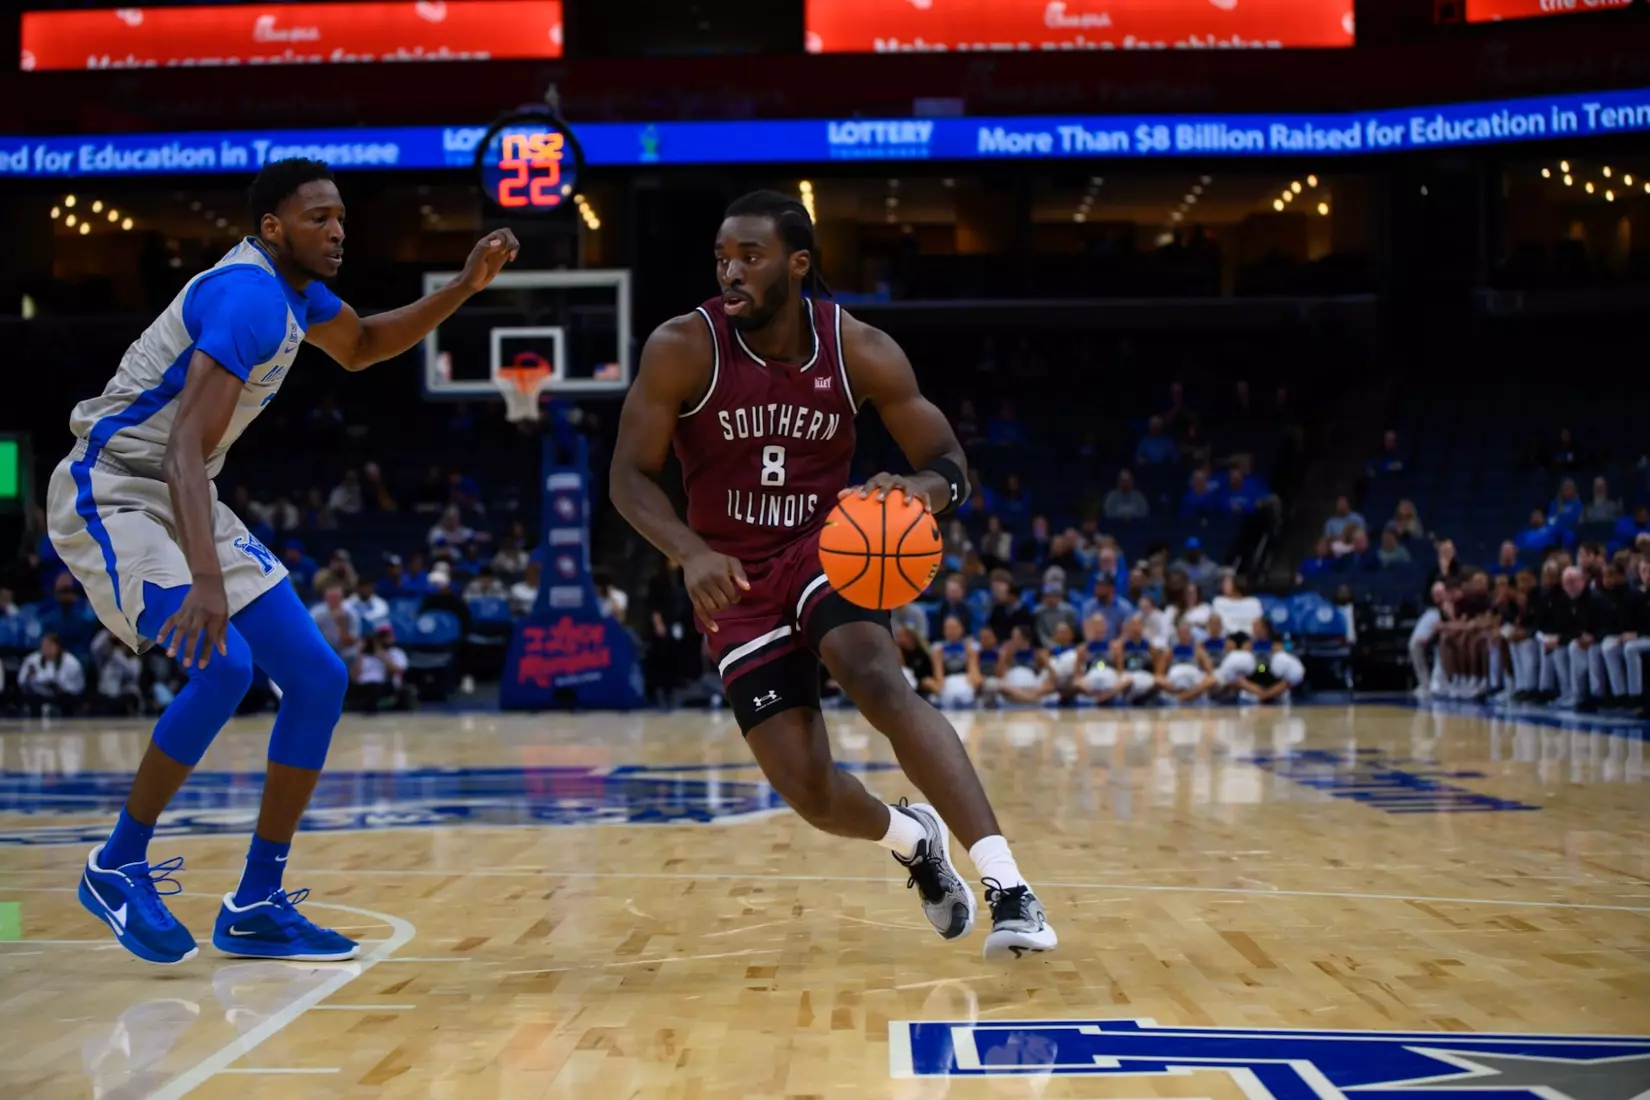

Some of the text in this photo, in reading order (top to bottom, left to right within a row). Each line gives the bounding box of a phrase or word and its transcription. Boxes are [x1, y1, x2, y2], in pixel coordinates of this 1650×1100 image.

[828, 120, 933, 144] LOTTERY
[979, 126, 1053, 153] More
[1057, 125, 1130, 152] Than
[1135, 122, 1170, 154] $8
[1175, 123, 1264, 150] Billion
[1269, 121, 1362, 150] Raised
[1366, 119, 1405, 147] for
[1410, 108, 1545, 143] Education
[1551, 105, 1577, 131] in
[34, 144, 74, 172] for
[79, 141, 216, 171] Education
[221, 140, 248, 167] in
[253, 140, 398, 167] Tennessee
[498, 160, 561, 207] 22
[718, 403, 840, 440] SOUTHERN
[761, 445, 786, 486] 8
[727, 489, 818, 527] ILLINOIS
